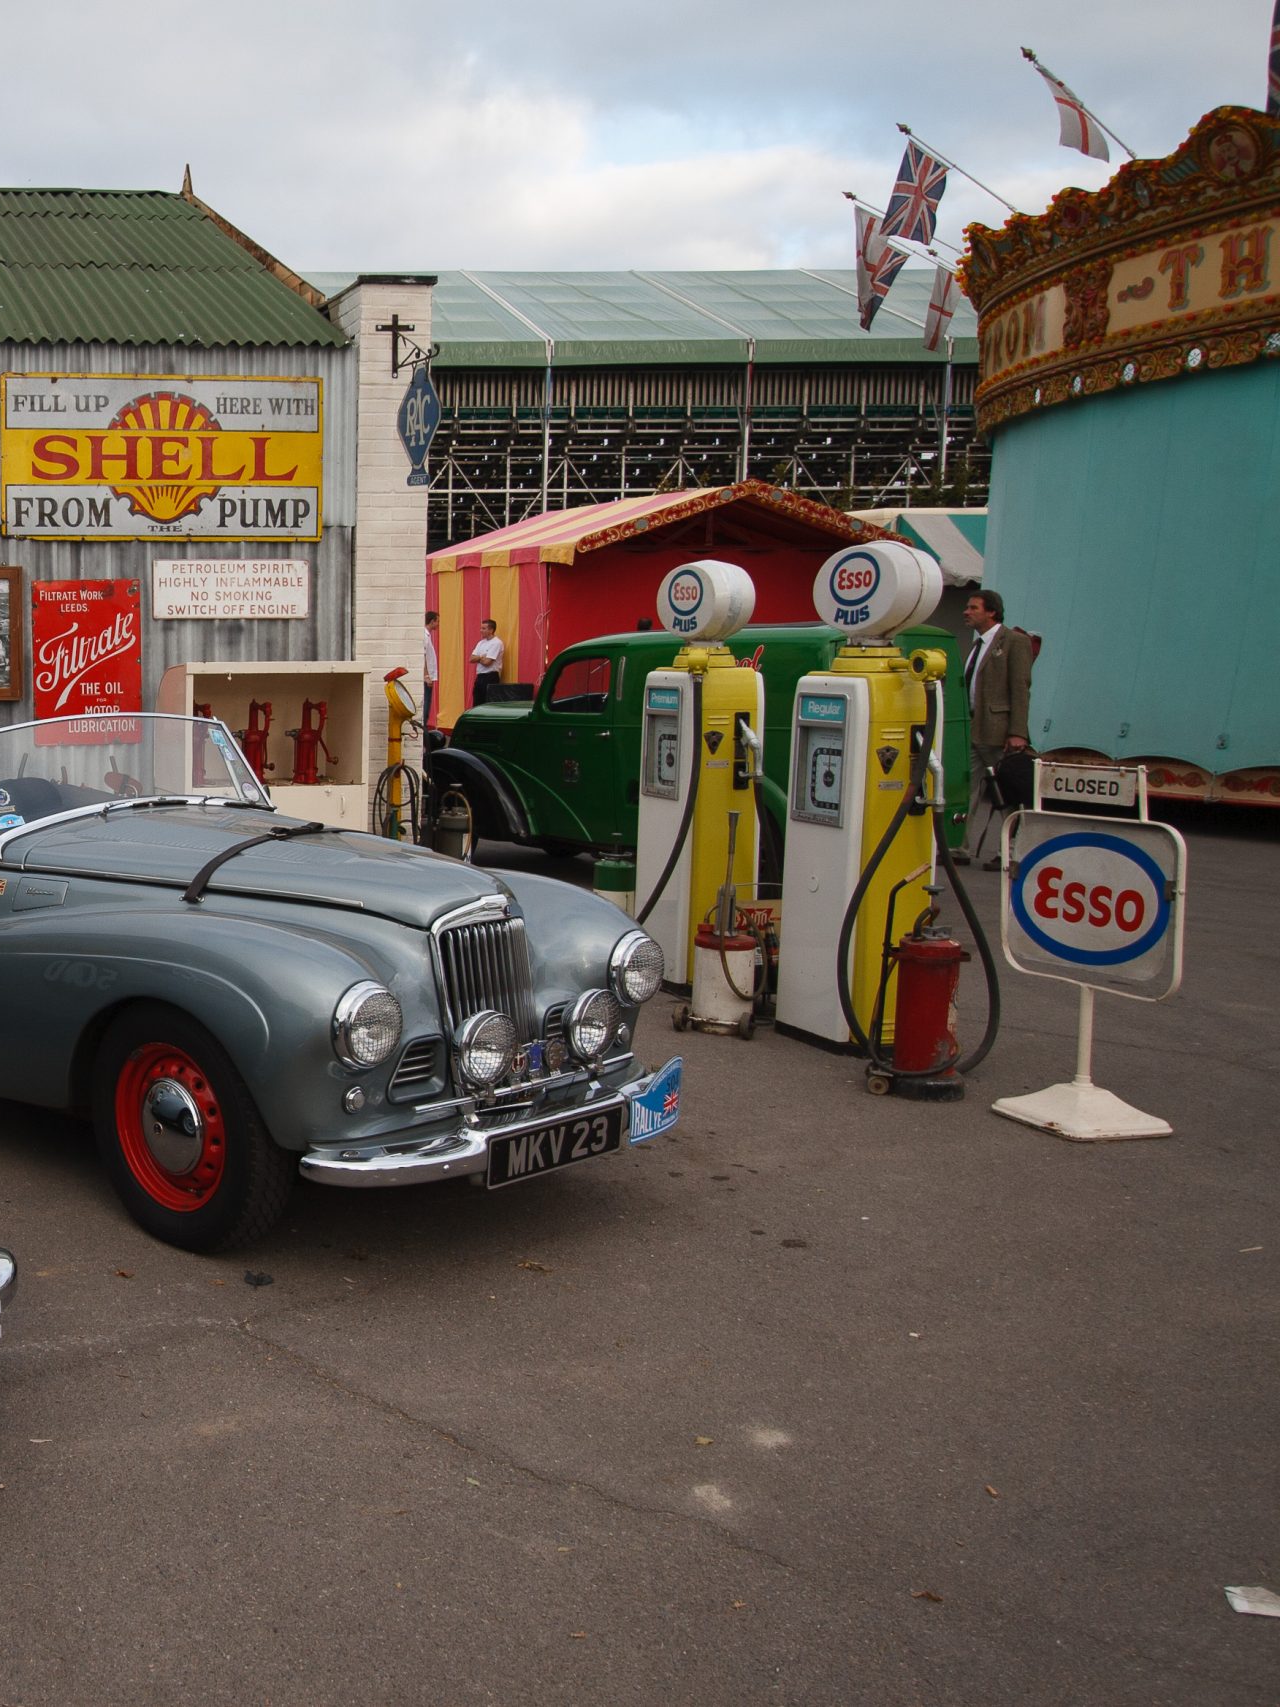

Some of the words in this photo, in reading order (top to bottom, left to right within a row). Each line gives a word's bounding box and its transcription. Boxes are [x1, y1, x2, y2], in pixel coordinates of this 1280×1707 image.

[12, 394, 67, 413] FILL
[74, 395, 110, 413] UP
[216, 397, 262, 416] HERE
[267, 397, 315, 416] WITH
[405, 388, 431, 447] RAC
[31, 434, 299, 481] SHELL
[409, 475, 427, 485] AGENT
[12, 497, 113, 528] FROM
[147, 525, 183, 533] THE
[216, 498, 311, 528] PUMP
[172, 564, 246, 574] PETROLEUM
[252, 563, 293, 574] SPIRIT
[159, 577, 208, 588] HIGHLY
[215, 577, 303, 588] INFLAMMABLE
[39, 590, 77, 601] FILTRATE
[190, 591, 209, 601] NO
[215, 591, 273, 601] SMOKING
[167, 605, 217, 615] SWITCH
[223, 604, 245, 615] OFF
[250, 604, 297, 615] ENGINE
[834, 605, 870, 625] PLUS
[672, 615, 698, 632] PLUS
[36, 612, 137, 692] Filtrate
[80, 682, 100, 695] THE
[105, 682, 124, 694] OIL
[651, 692, 678, 704] Premium
[84, 705, 120, 714] MOTOR
[807, 700, 841, 716] Regular
[1053, 777, 1119, 797] CLOSED
[507, 1126, 566, 1178] MKV
[571, 1116, 608, 1159] 23
